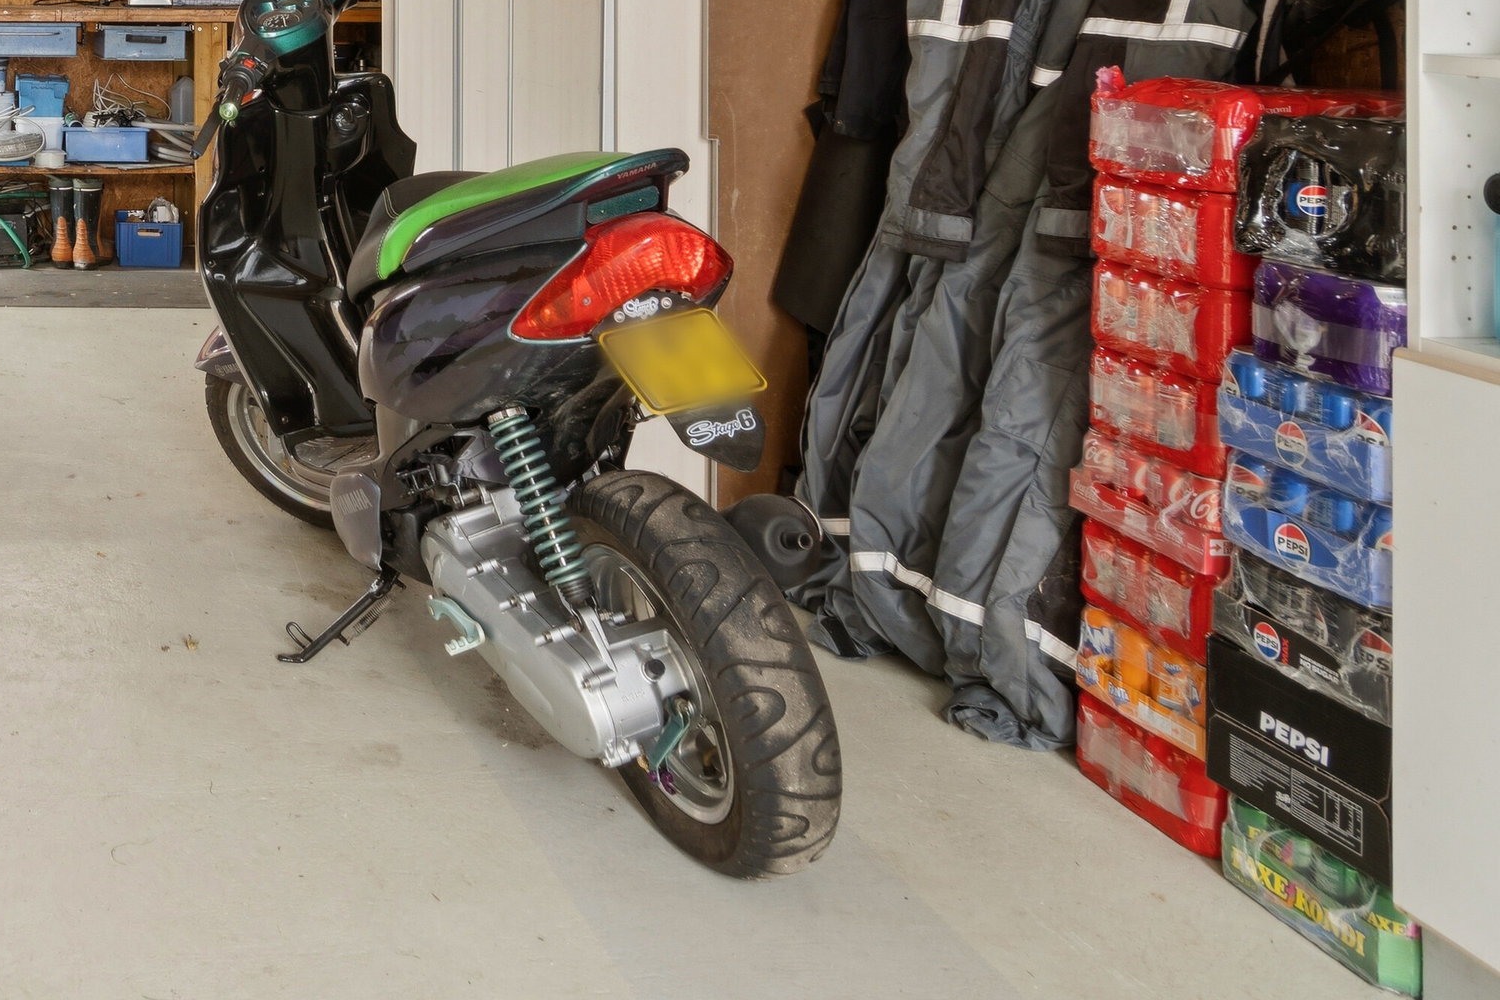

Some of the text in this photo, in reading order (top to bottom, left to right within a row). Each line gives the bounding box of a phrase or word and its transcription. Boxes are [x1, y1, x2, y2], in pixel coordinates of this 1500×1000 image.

[617, 162, 657, 180] YAMAHA
[1299, 196, 1326, 205] PEP
[686, 410, 756, 446] Stage6
[1277, 535, 1309, 556] PEPSI
[1256, 632, 1279, 651] PEPSI
[1259, 710, 1330, 768] PEPSI
